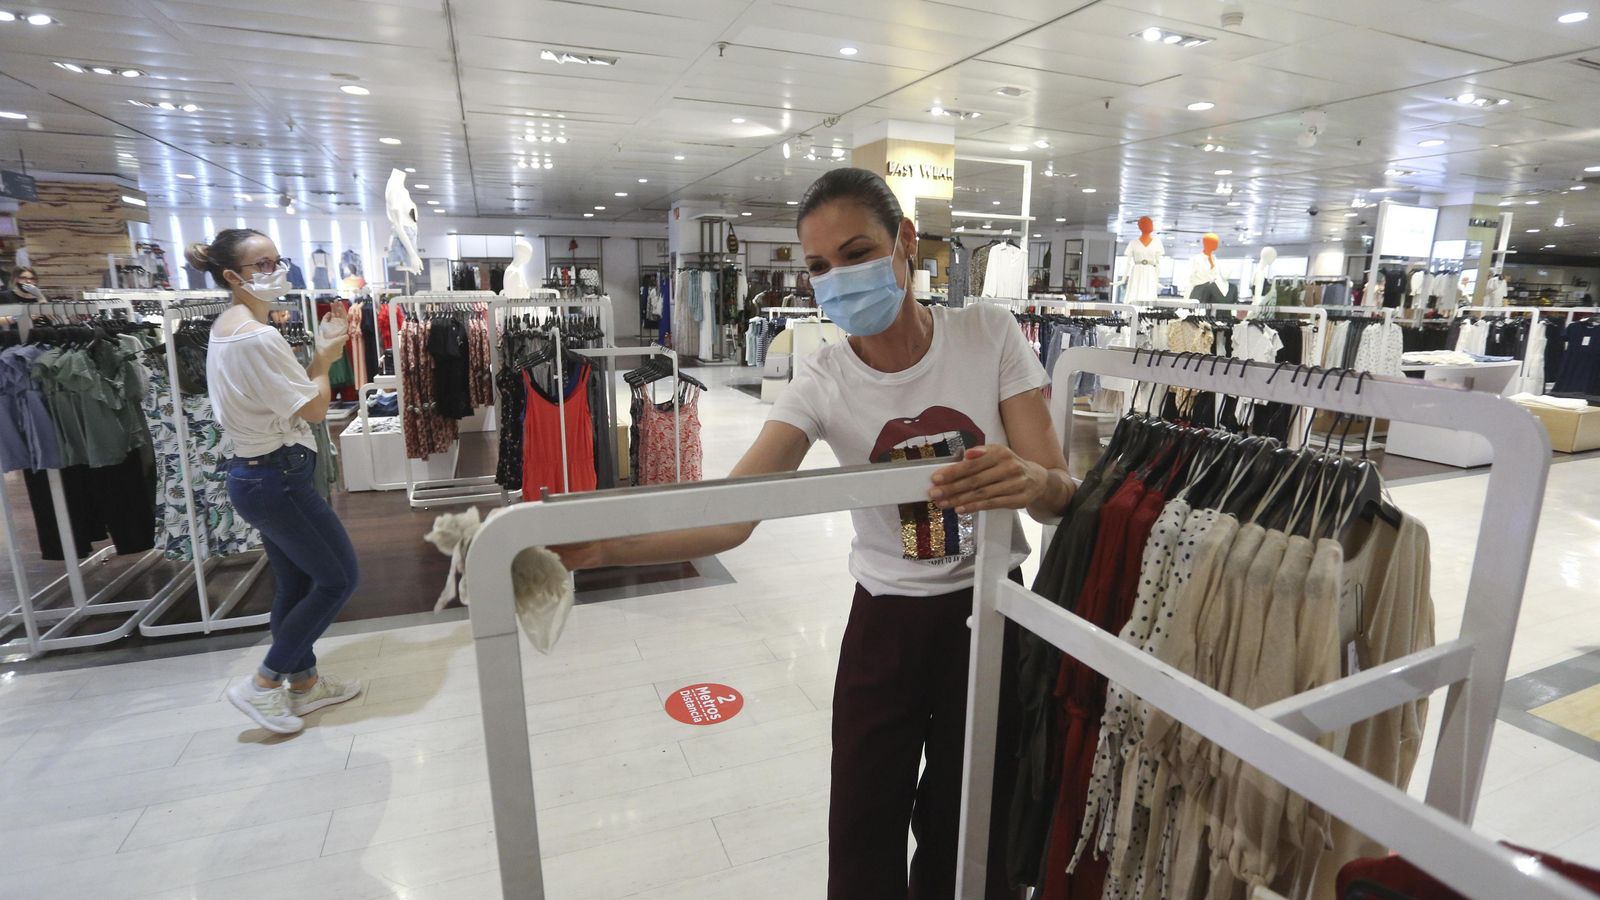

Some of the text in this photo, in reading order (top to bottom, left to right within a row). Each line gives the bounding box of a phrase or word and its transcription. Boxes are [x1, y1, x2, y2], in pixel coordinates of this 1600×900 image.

[679, 690, 703, 723] Distancia
[695, 686, 722, 720] Metros
[716, 694, 737, 704] 2
